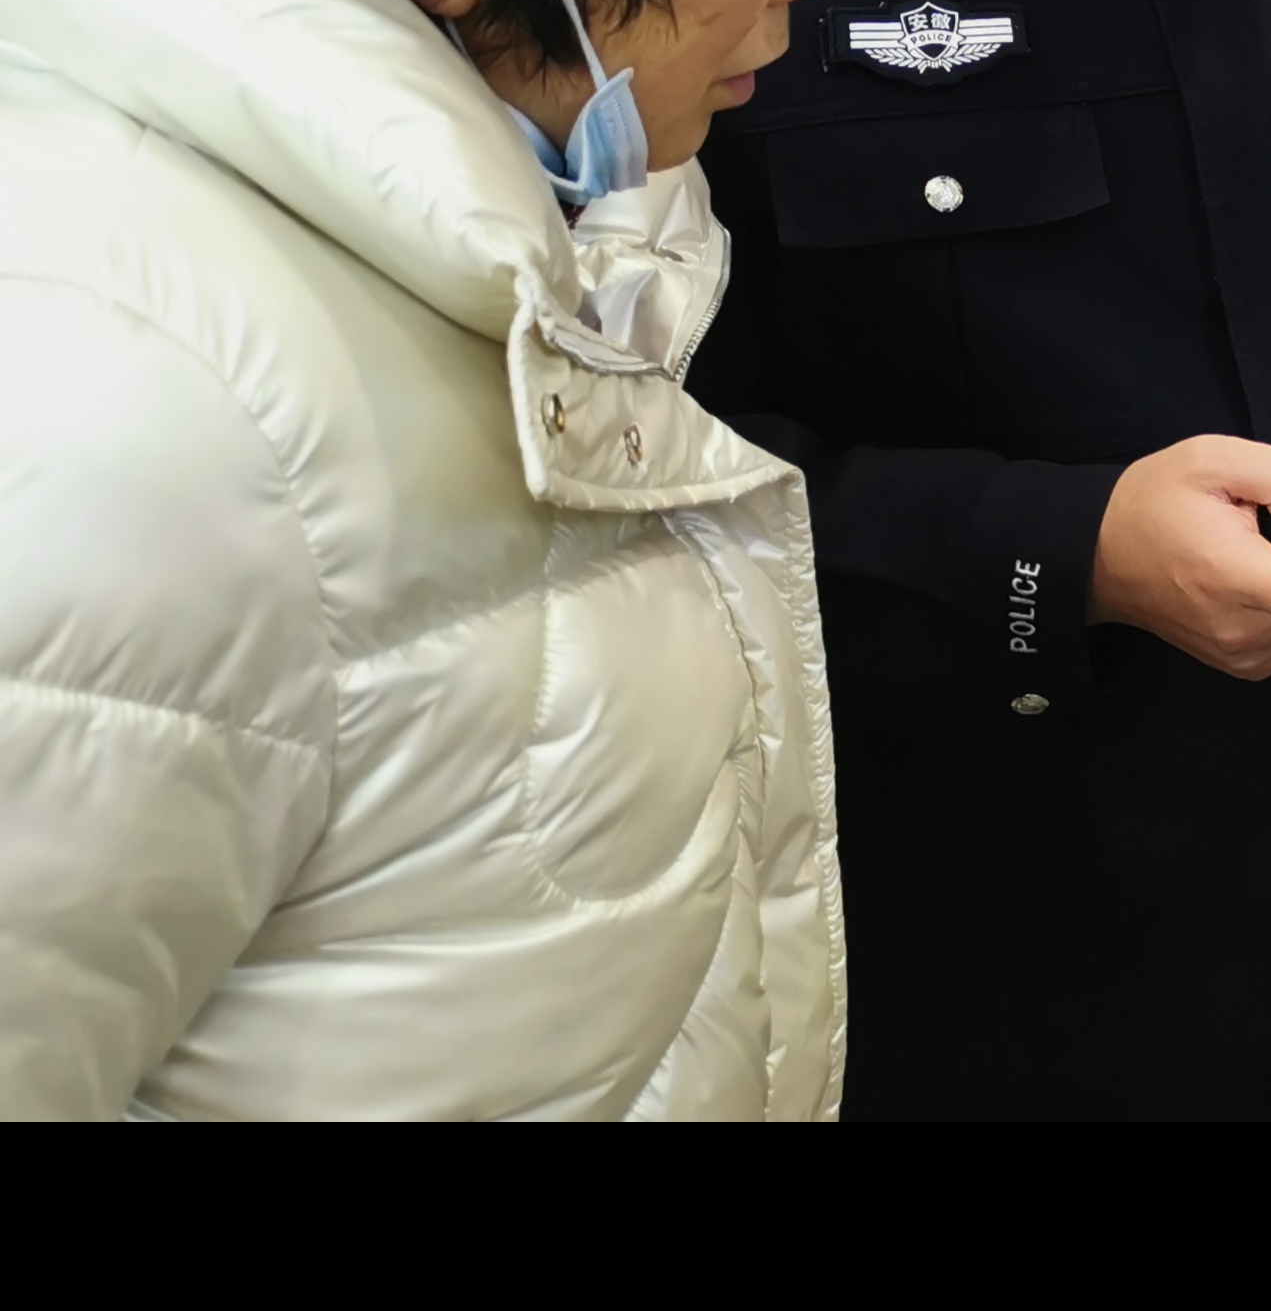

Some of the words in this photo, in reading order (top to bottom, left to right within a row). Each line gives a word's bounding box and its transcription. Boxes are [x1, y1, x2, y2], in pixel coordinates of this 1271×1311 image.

[907, 12, 952, 33] 安徽
[910, 33, 953, 46] POLICE
[1008, 558, 1041, 653] POLICE
